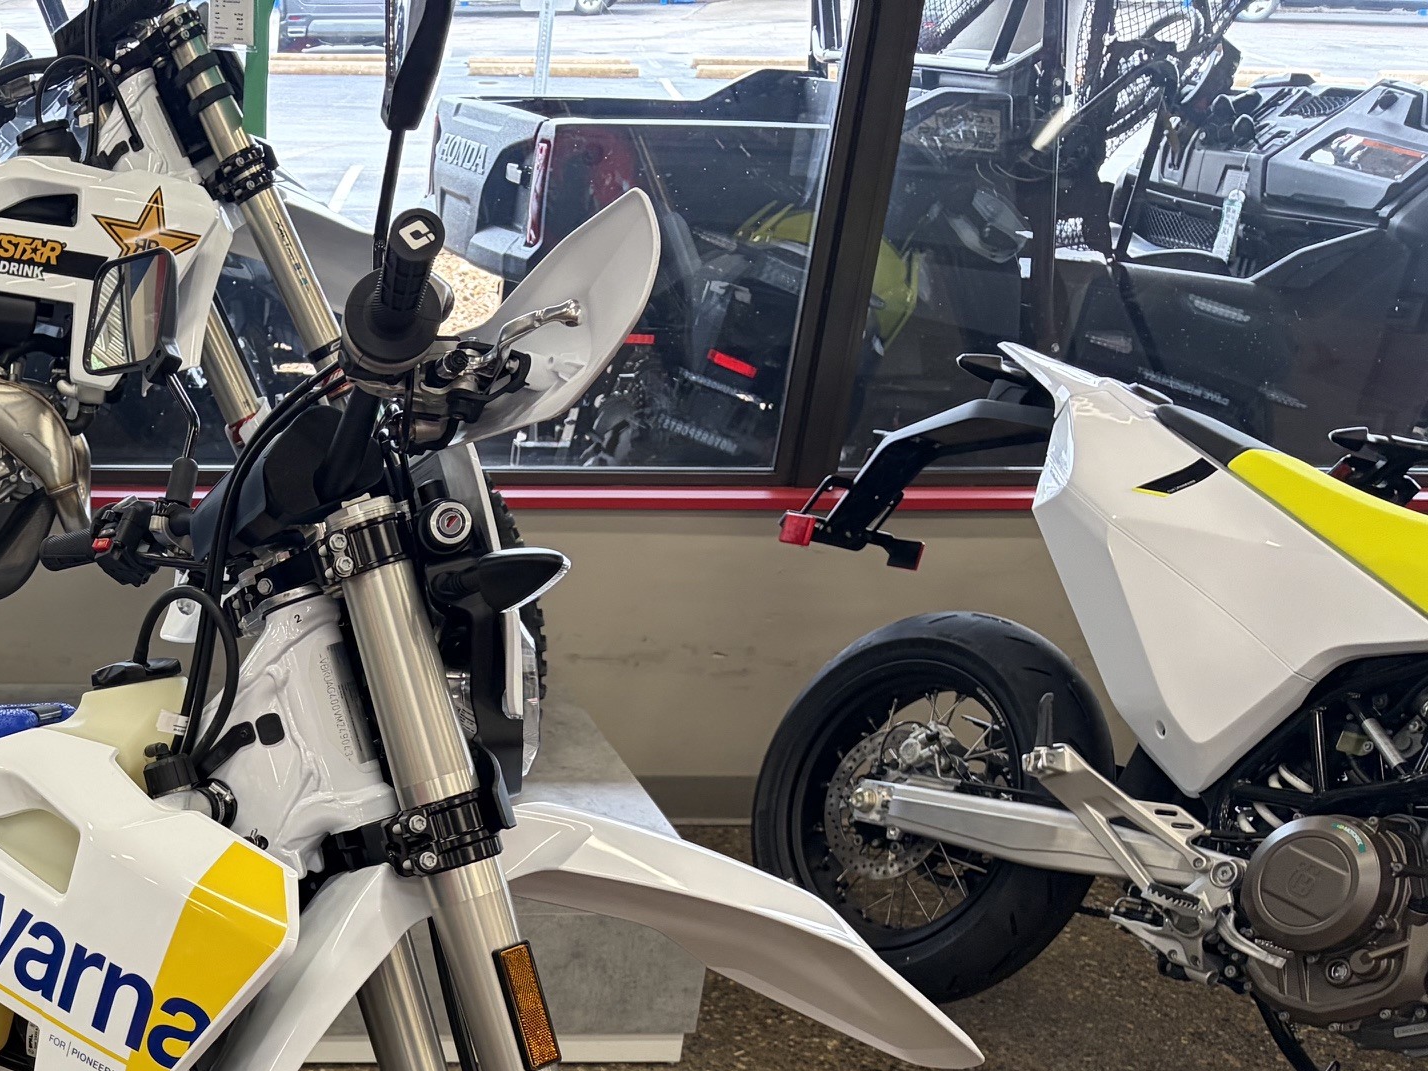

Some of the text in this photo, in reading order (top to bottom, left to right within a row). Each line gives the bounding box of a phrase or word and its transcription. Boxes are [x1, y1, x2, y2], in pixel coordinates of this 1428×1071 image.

[439, 132, 489, 176] HONDA
[293, 614, 303, 624] 2
[48, 1034, 67, 1051] FOR
